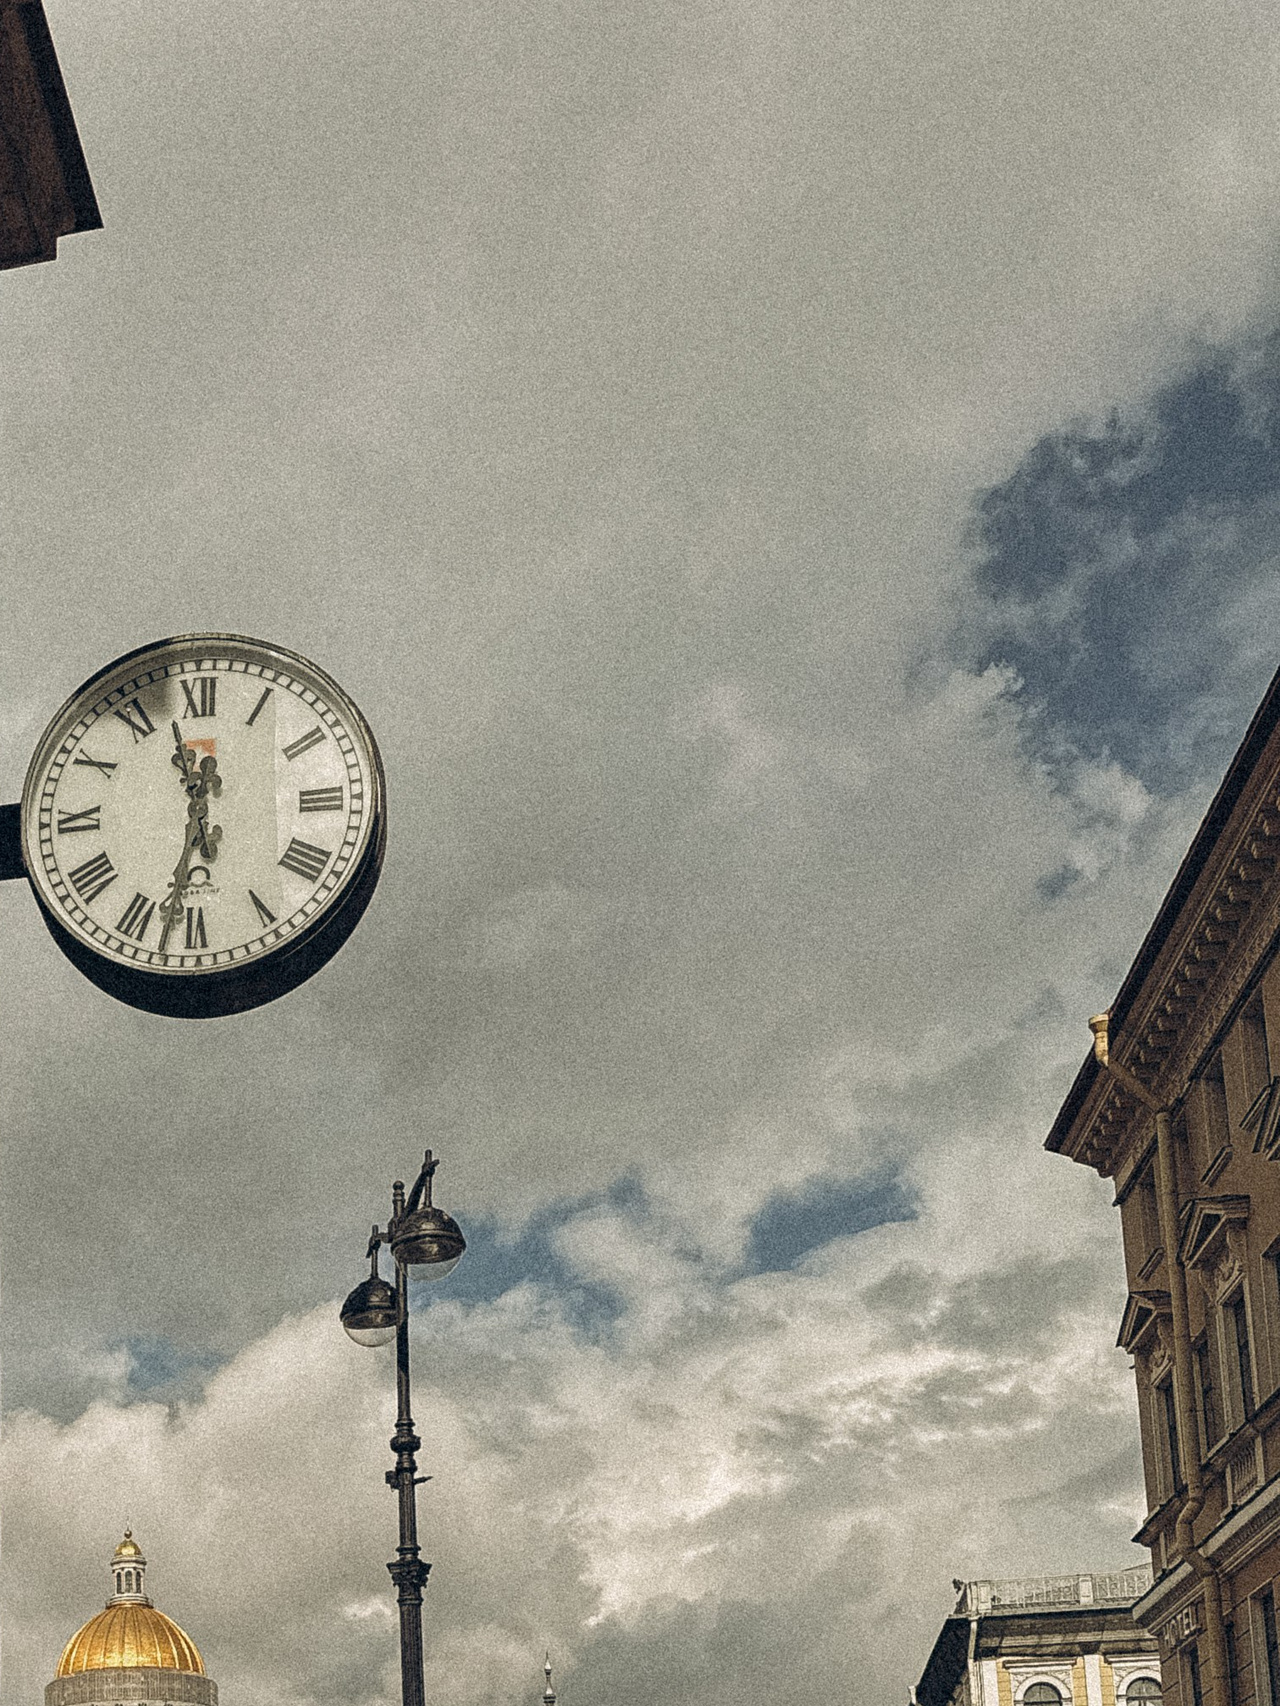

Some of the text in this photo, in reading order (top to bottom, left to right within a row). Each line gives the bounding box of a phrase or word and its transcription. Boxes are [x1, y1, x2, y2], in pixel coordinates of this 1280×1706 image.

[180, 676, 219, 719] XII
[245, 687, 274, 726] I
[113, 698, 157, 743] XI
[73, 748, 118, 779] X
[282, 725, 327, 761] II
[57, 805, 101, 834] IX
[299, 786, 343, 813] III
[68, 851, 118, 905] VIII
[115, 892, 156, 942] VII
[184, 906, 209, 949] VI
[249, 889, 277, 928] V
[1162, 1605, 1197, 1648] HOTEL
